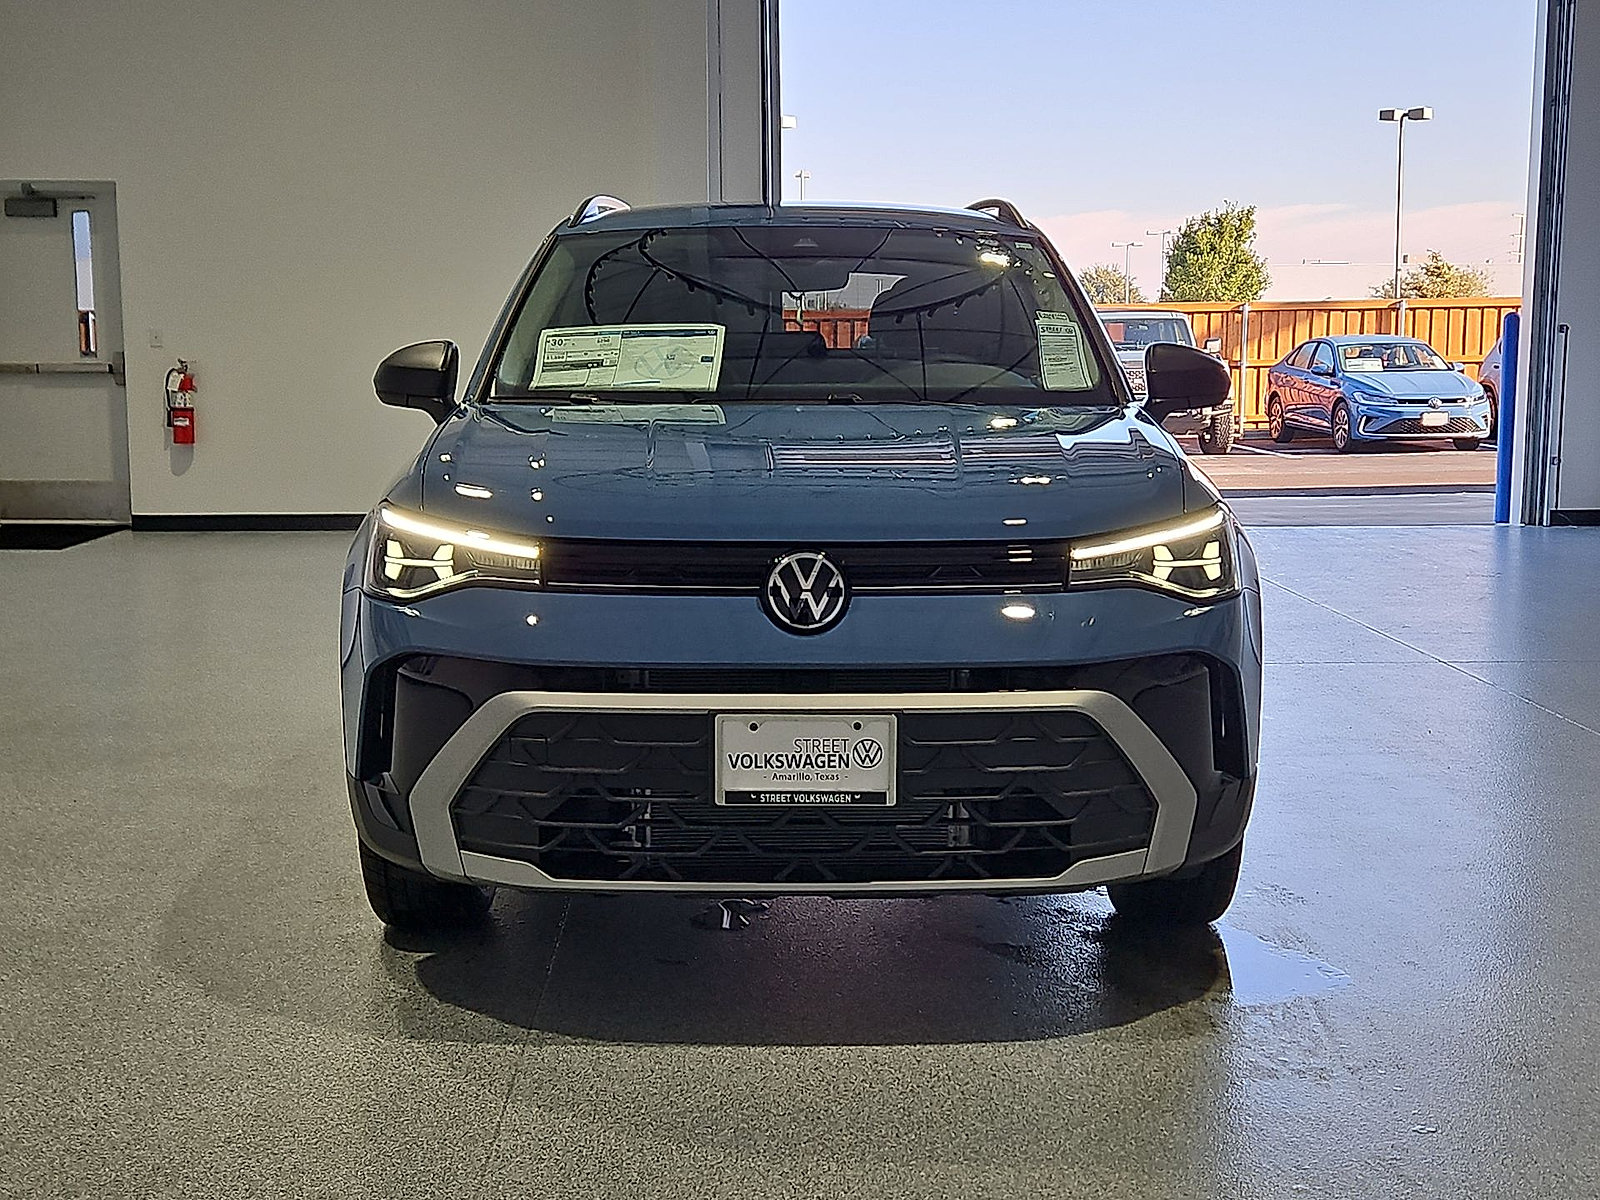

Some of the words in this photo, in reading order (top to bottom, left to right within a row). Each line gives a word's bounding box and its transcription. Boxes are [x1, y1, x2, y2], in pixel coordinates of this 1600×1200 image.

[793, 738, 850, 754] STREET
[727, 753, 850, 770] VOLKSWAGEN
[772, 772, 813, 782] Amarillo,
[815, 772, 840, 781] Texas
[760, 793, 791, 803] STREET
[793, 793, 851, 803] VOLKSWAGEN
